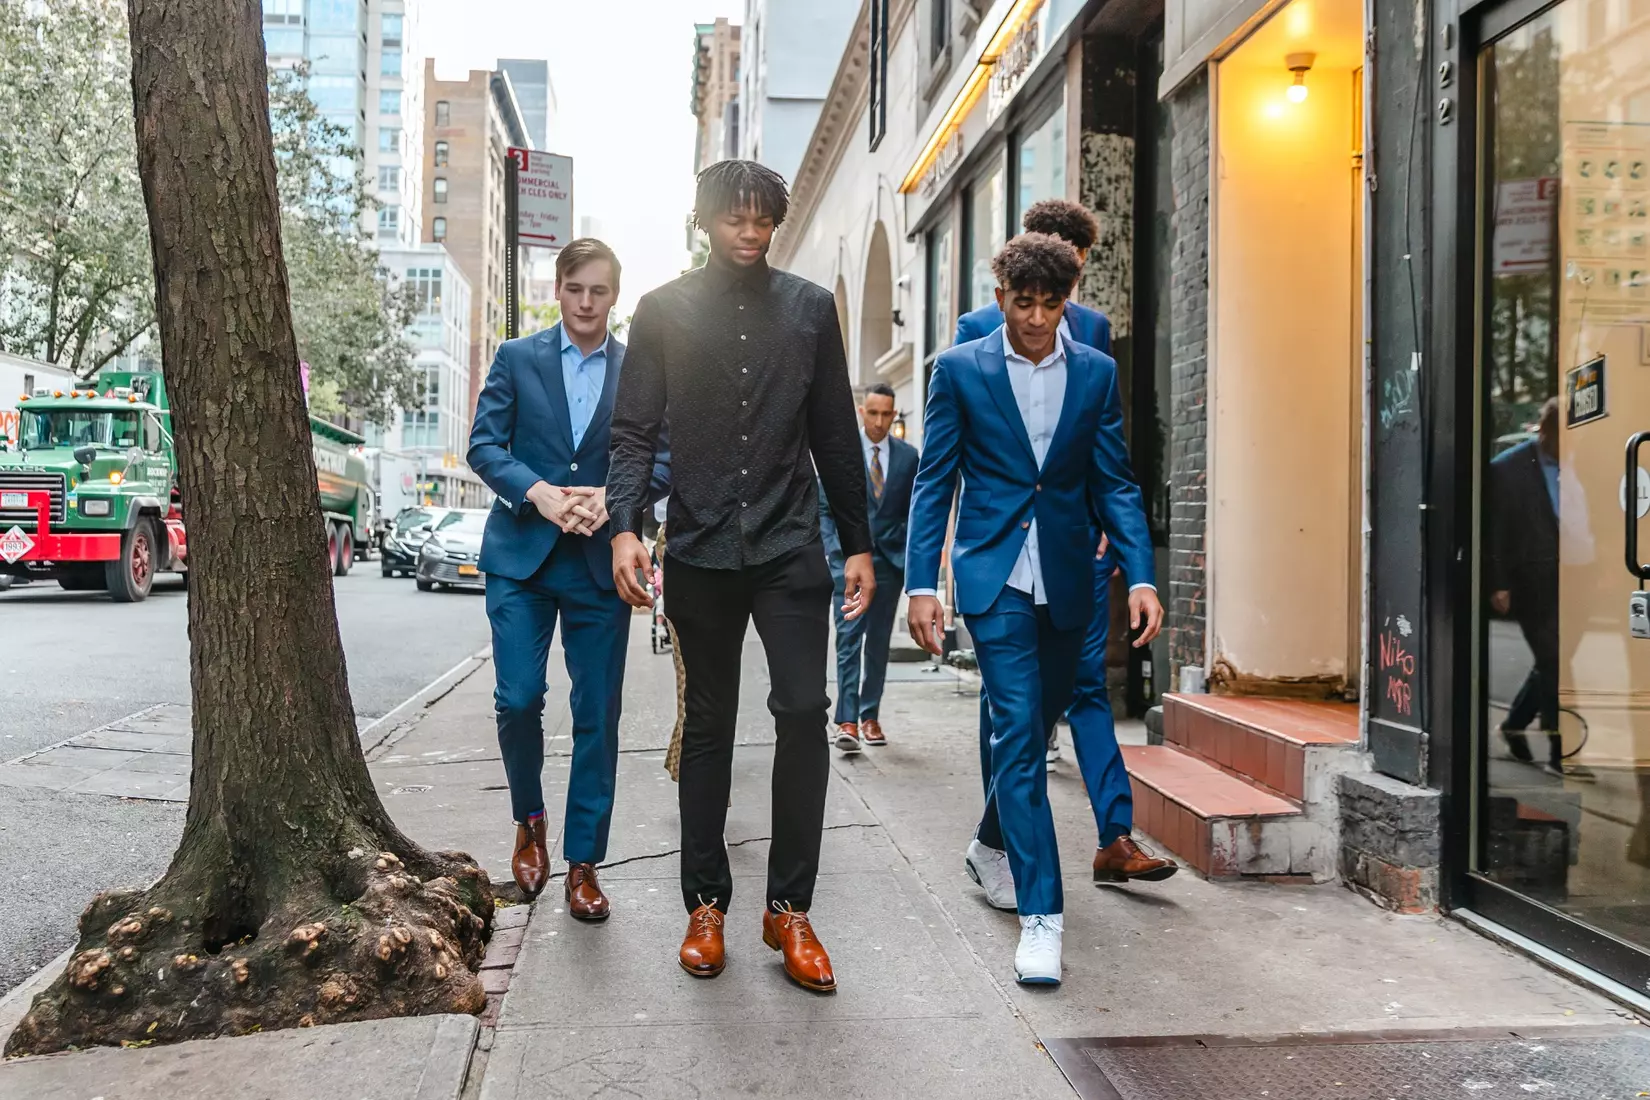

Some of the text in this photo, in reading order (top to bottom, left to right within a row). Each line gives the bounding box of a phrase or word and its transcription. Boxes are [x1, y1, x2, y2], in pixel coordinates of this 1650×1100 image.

[513, 150, 525, 170] 3
[518, 176, 559, 189] OMMERCIAL
[548, 190, 568, 200] ONLY
